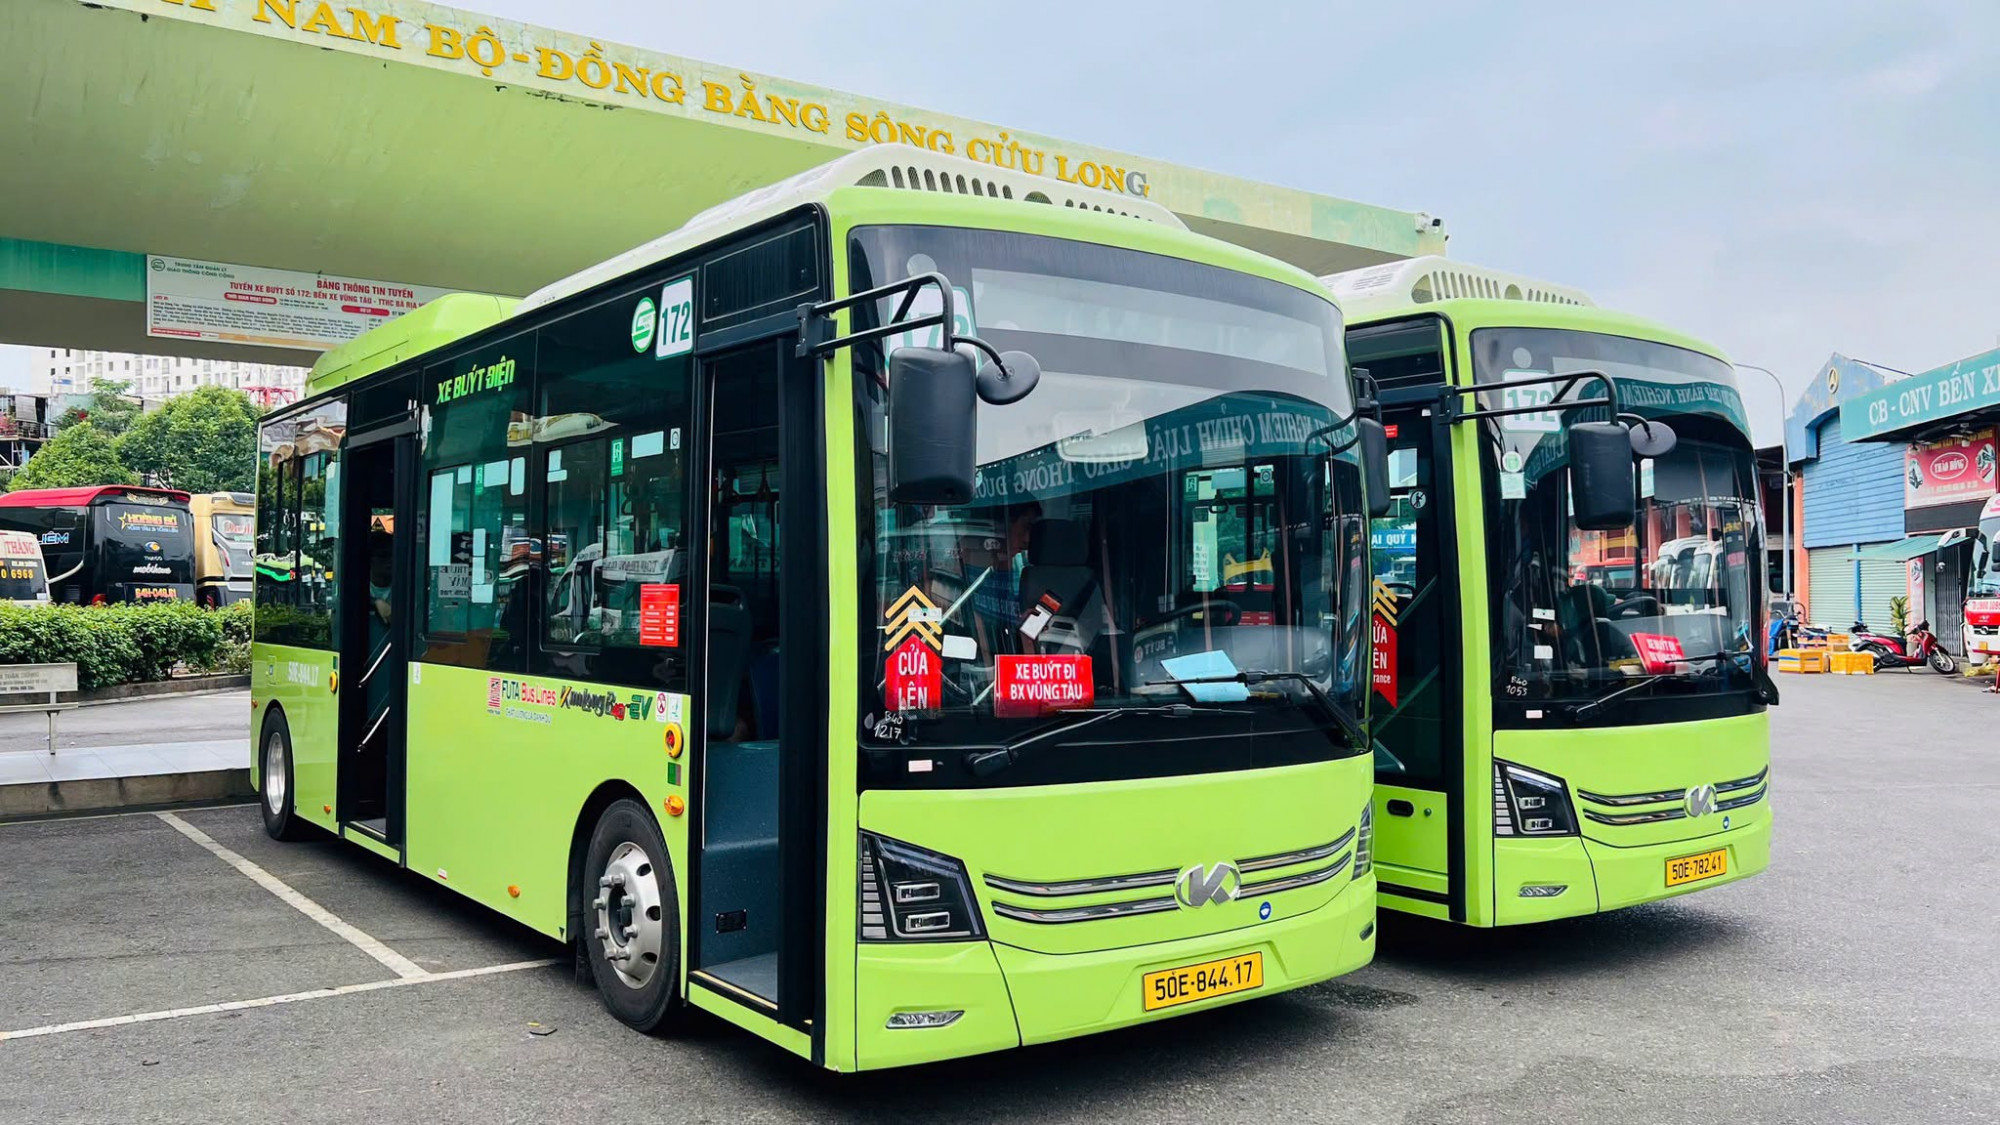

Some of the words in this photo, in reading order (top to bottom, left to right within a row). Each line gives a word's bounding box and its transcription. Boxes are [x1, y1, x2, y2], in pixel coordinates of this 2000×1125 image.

[252, 0, 402, 50] NAM
[701, 73, 831, 134] BẰNG
[845, 110, 955, 155] SÔNG
[966, 131, 1044, 176] CỬU
[1055, 155, 1149, 198] LONG
[229, 281, 253, 292] TUYẾN
[254, 284, 264, 293] XE
[285, 286, 296, 296] SỐ
[297, 289, 311, 298] 172:
[329, 292, 339, 301] XE
[339, 293, 358, 303] VŨNG
[316, 278, 341, 290] BẢNG
[342, 281, 370, 295] THÔNG
[372, 286, 386, 296] TIN
[388, 287, 414, 299] TUYẾN
[661, 300, 691, 346] 172
[436, 379, 453, 405] XE
[453, 364, 486, 399] BUÝT
[485, 355, 516, 391] ĐIỆN
[1507, 389, 1555, 423] 172
[1868, 399, 1889, 426] CB
[1899, 384, 1933, 417] CNV
[1937, 361, 1976, 408] BẾN
[40, 530, 69, 544] IÊM
[1373, 620, 1388, 644] ỬA
[898, 644, 928, 676] CỬA
[1015, 664, 1029, 680] XE
[1032, 656, 1061, 680] BUÝT
[1063, 664, 1077, 680] ĐI
[1373, 647, 1388, 669] ÊN
[1010, 683, 1025, 700] BX
[1028, 679, 1059, 702] VŨNG
[1061, 680, 1084, 701] TÀU
[1373, 674, 1392, 684] rance
[1506, 685, 1528, 696] 1053
[502, 679, 520, 700] FUTA
[521, 682, 536, 703] Bus
[536, 683, 556, 706] Lines
[897, 682, 928, 711] LÊN
[885, 710, 903, 724] B40
[1671, 854, 1722, 880] 50E-782.41
[1154, 960, 1254, 1002] 50E-844.17
